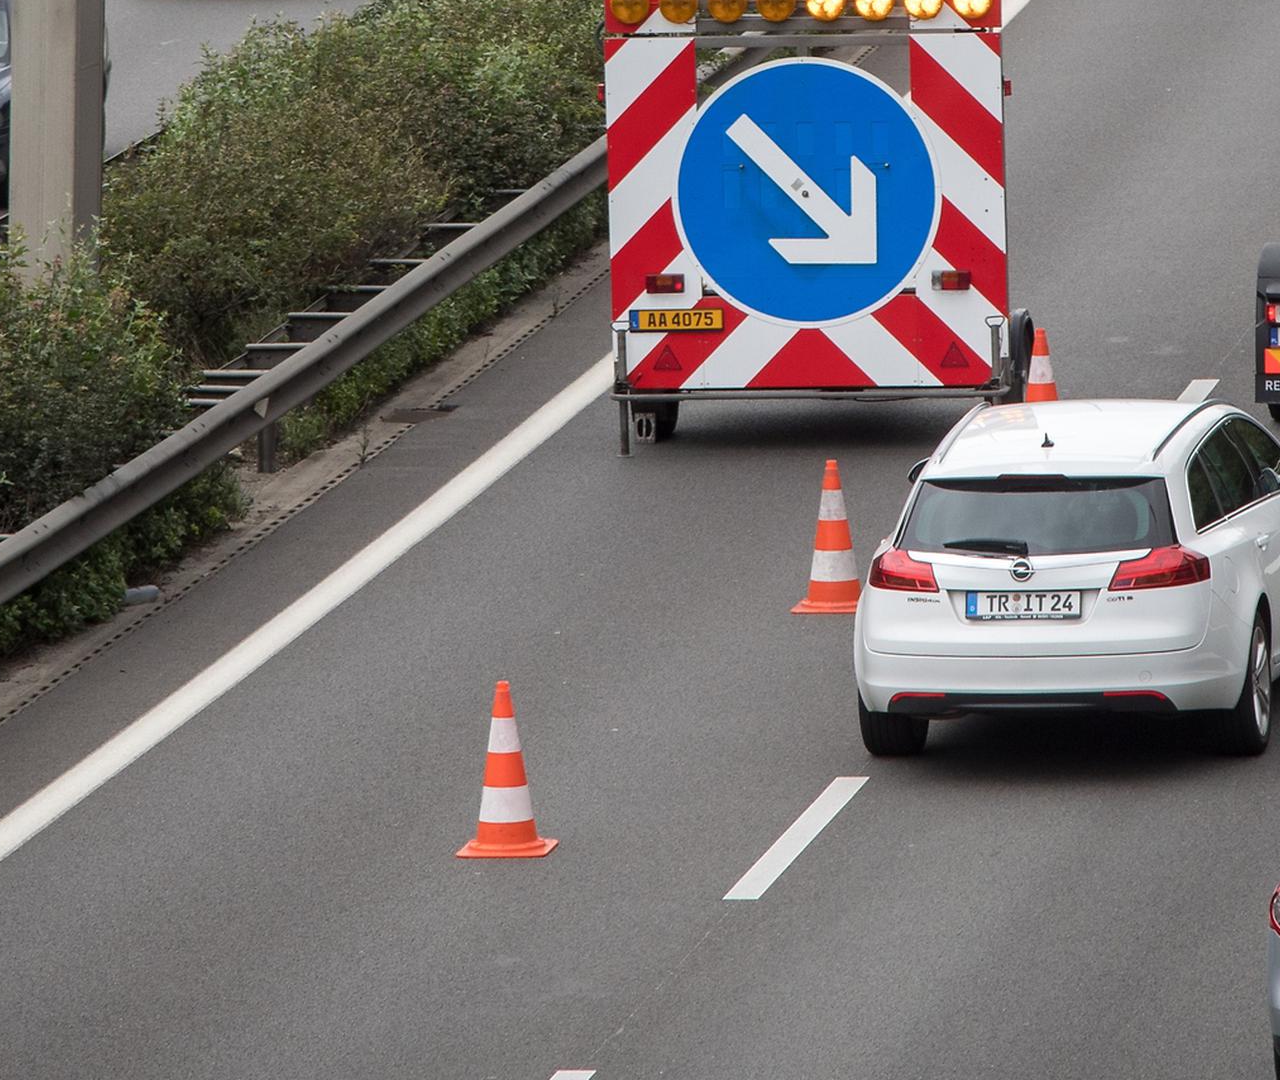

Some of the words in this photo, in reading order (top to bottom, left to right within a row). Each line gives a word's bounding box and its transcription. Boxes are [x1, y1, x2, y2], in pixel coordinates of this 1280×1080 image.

[648, 312, 668, 327] AA
[672, 312, 714, 327] 4075
[986, 594, 1010, 612] TR
[1023, 594, 1047, 611] IT
[1051, 593, 1074, 612] 24
